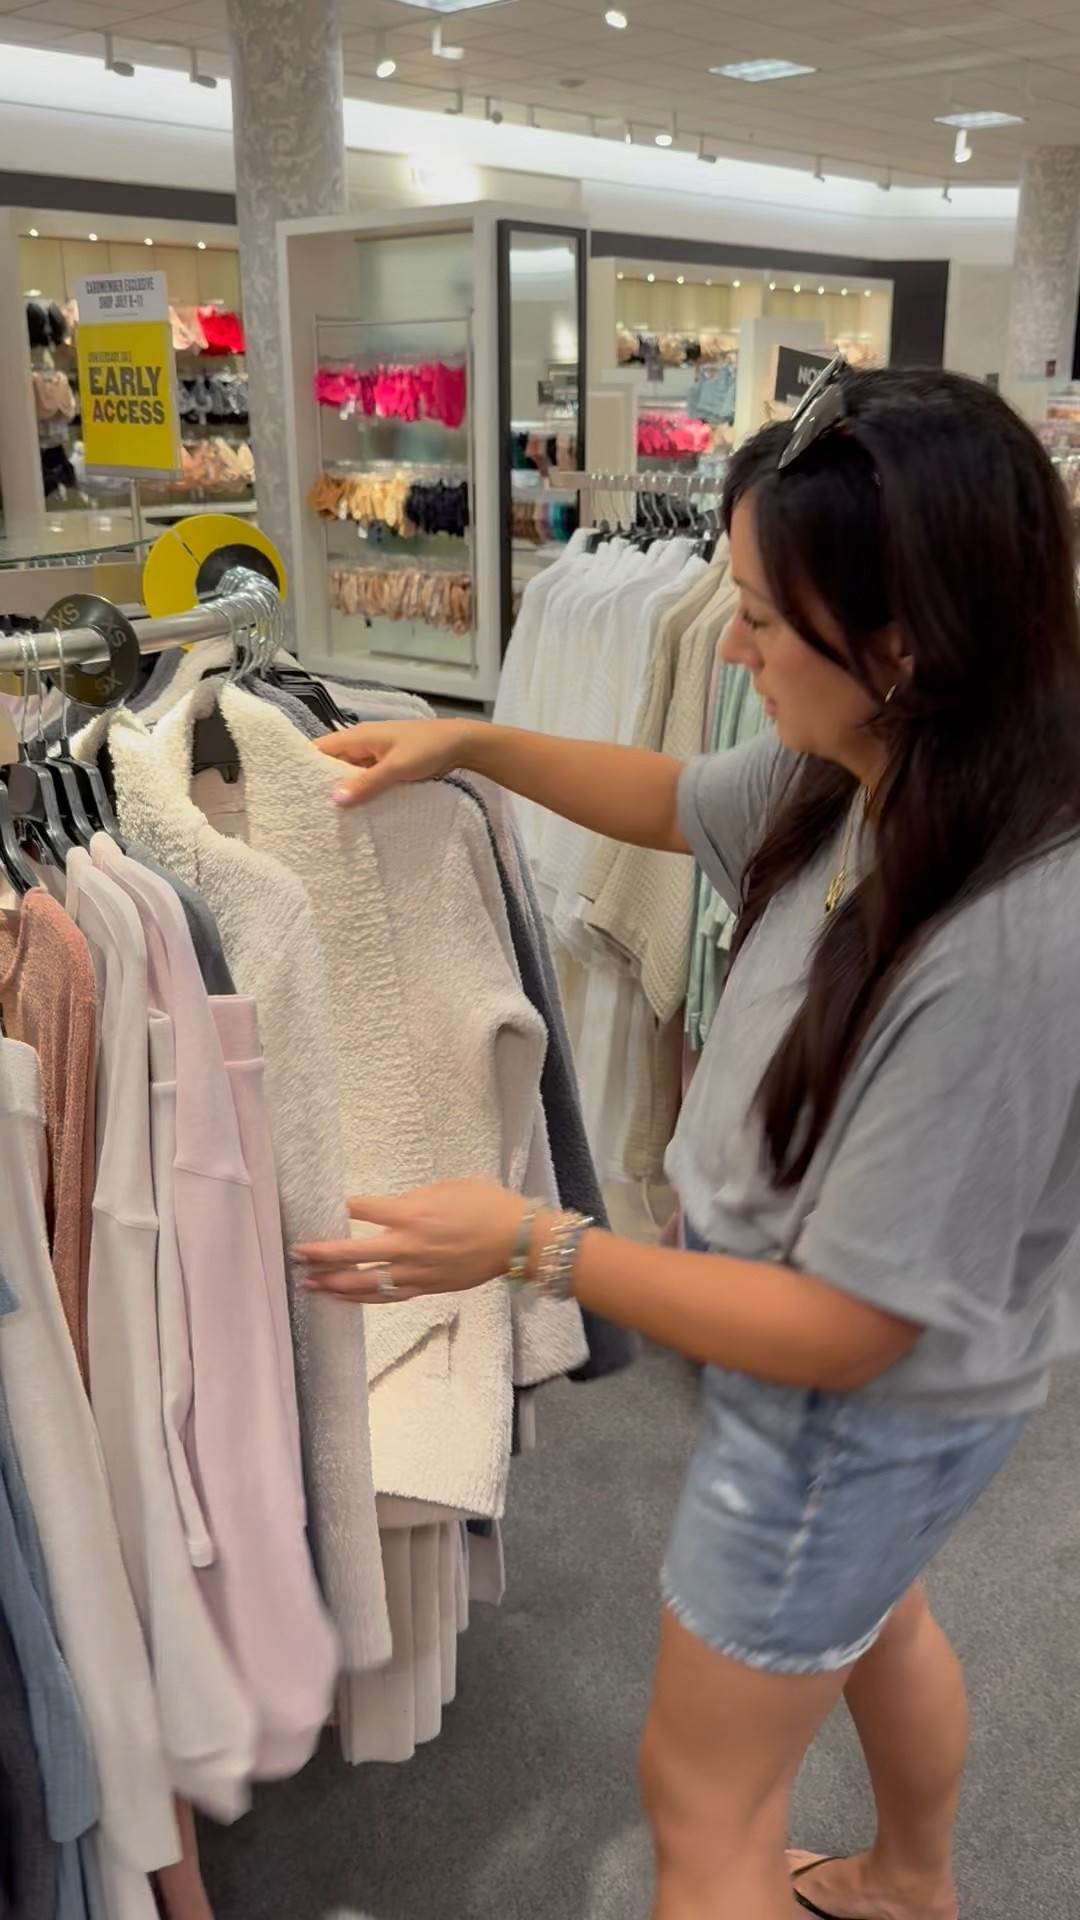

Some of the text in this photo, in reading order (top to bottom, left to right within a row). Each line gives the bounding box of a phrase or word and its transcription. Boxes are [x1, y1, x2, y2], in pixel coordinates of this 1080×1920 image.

[89, 366, 162, 396] EARLY
[798, 365, 823, 385] NO
[94, 398, 165, 425] ACCESS
[52, 602, 81, 630] XS
[100, 616, 128, 648] XS
